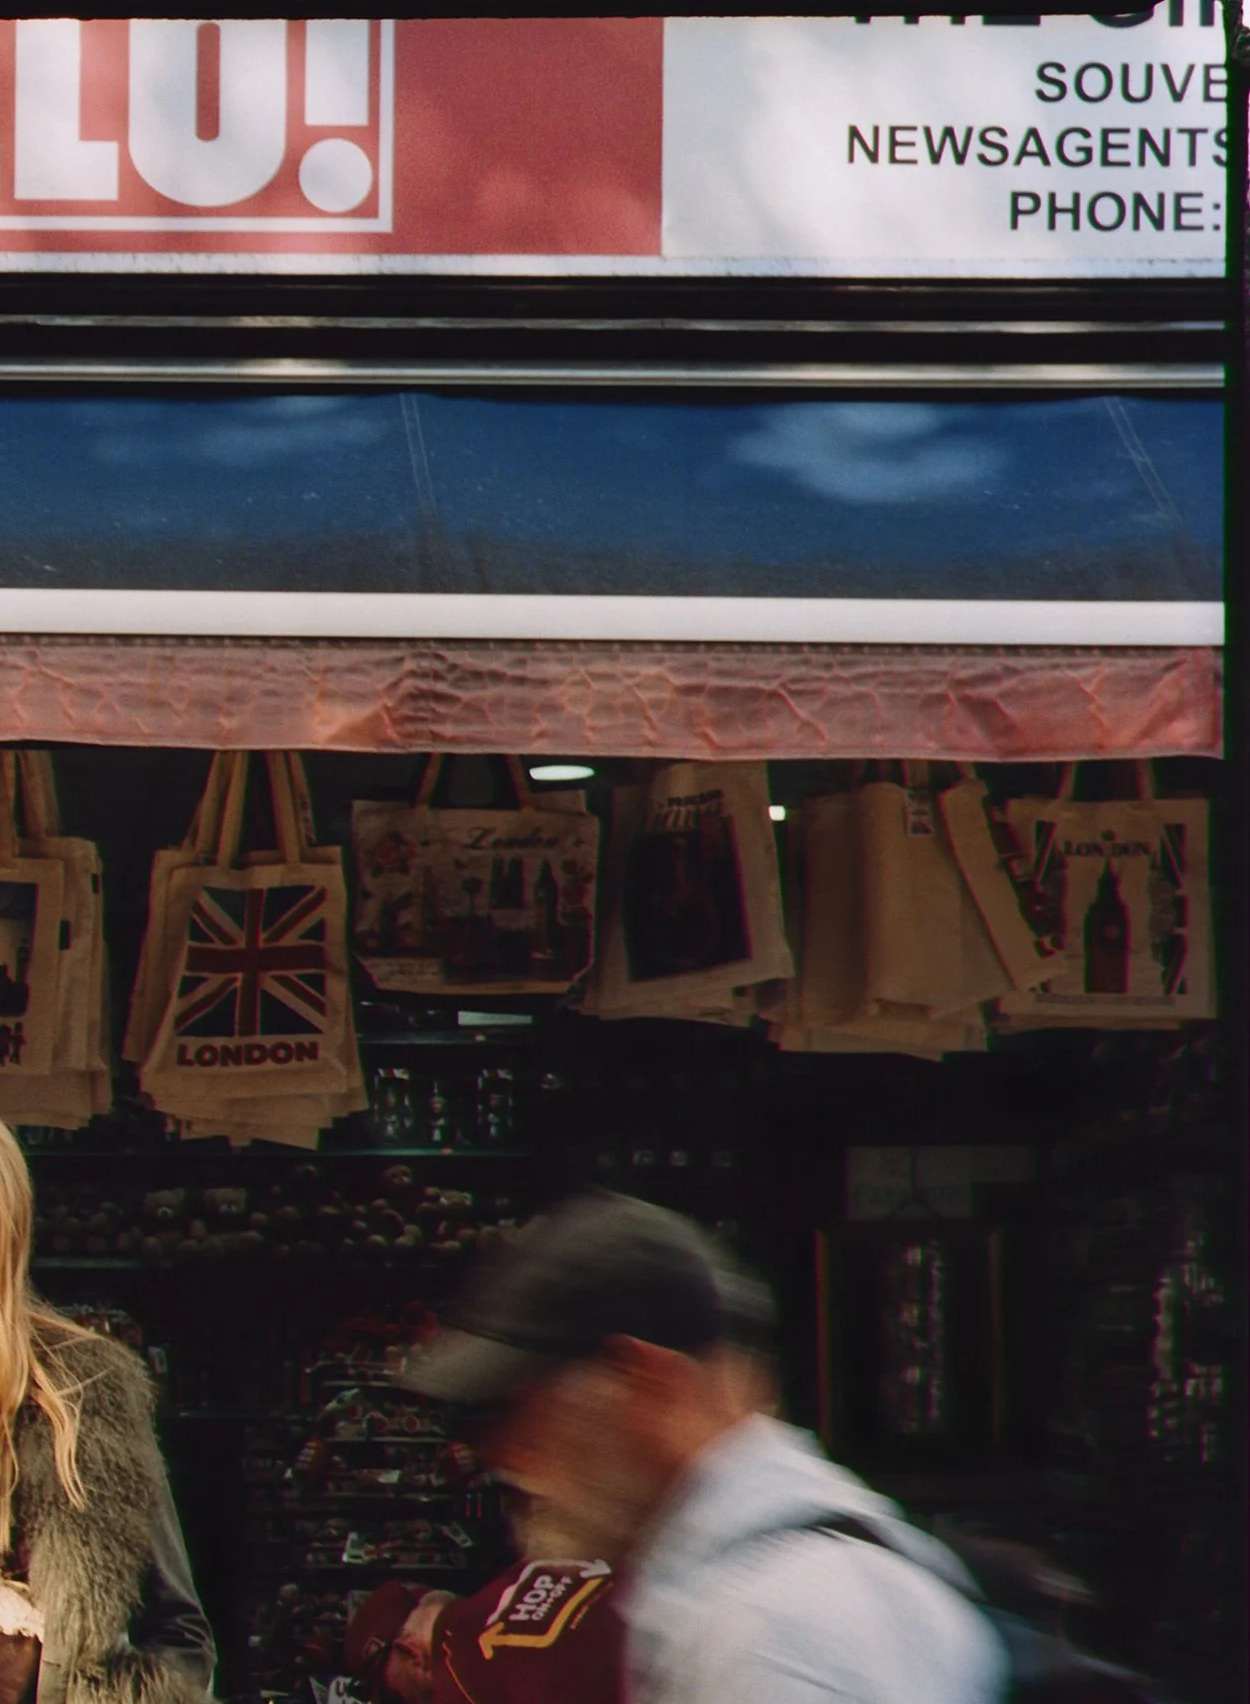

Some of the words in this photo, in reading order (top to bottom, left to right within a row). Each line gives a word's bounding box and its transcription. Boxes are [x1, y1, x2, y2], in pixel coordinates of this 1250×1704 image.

[1035, 62, 1227, 103] SOUVE
[1010, 191, 1222, 232] PHONE:
[176, 1041, 319, 1067] LONDON
[508, 1574, 555, 1621] HOP
